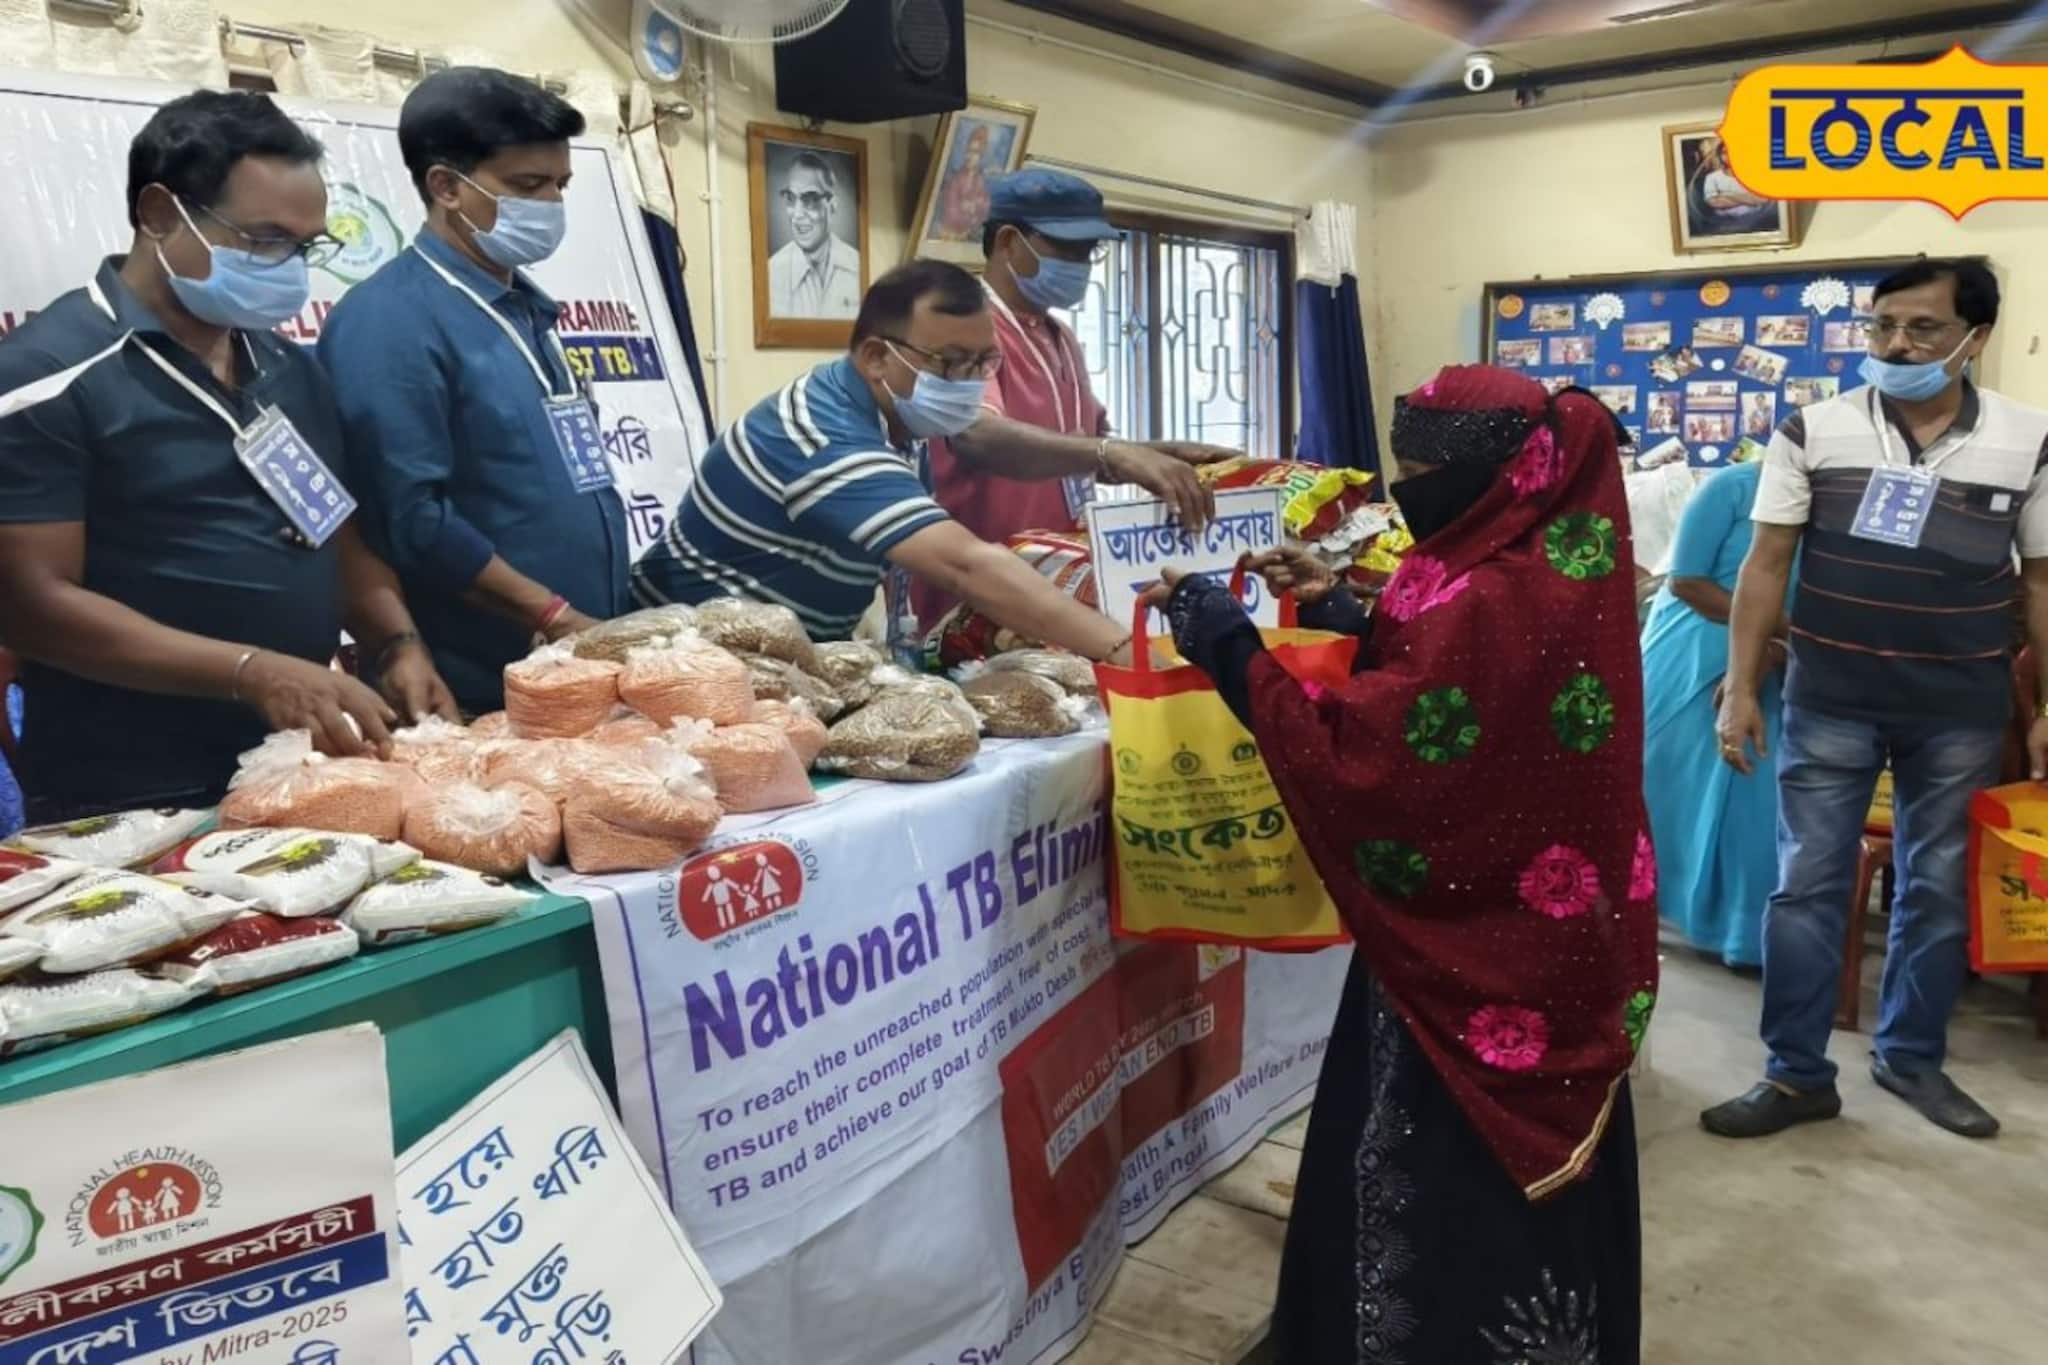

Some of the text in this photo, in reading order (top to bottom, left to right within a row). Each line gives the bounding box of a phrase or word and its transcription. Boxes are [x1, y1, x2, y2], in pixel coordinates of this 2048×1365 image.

[1204, 508, 1275, 553] সেবায়
[684, 883, 941, 1073] National
[946, 850, 1003, 941] TB
[698, 1108, 734, 1132] To
[743, 1067, 801, 1117] reach
[813, 1048, 847, 1078] the
[853, 987, 952, 1057] unreached
[959, 941, 1024, 1006] population
[704, 1118, 799, 1172] ensure
[804, 1085, 849, 1126] their
[856, 1032, 942, 1095] complete
[952, 979, 1015, 1038] treatment
[1018, 960, 1042, 987] free
[1046, 941, 1061, 964] of
[1062, 926, 1091, 954] cost
[1185, 1011, 1212, 1038] TB
[707, 965, 1077, 1208] TB and achieve our goal of TB Mukto Desh
[412, 1126, 515, 1215] হয়ে
[196, 1207, 357, 1272] কর্মসূচী
[430, 1196, 524, 1291] হাত
[156, 1258, 343, 1337] জিতবে
[202, 1299, 349, 1364] Mitra-2025
[480, 1242, 569, 1343] মুক্ত
